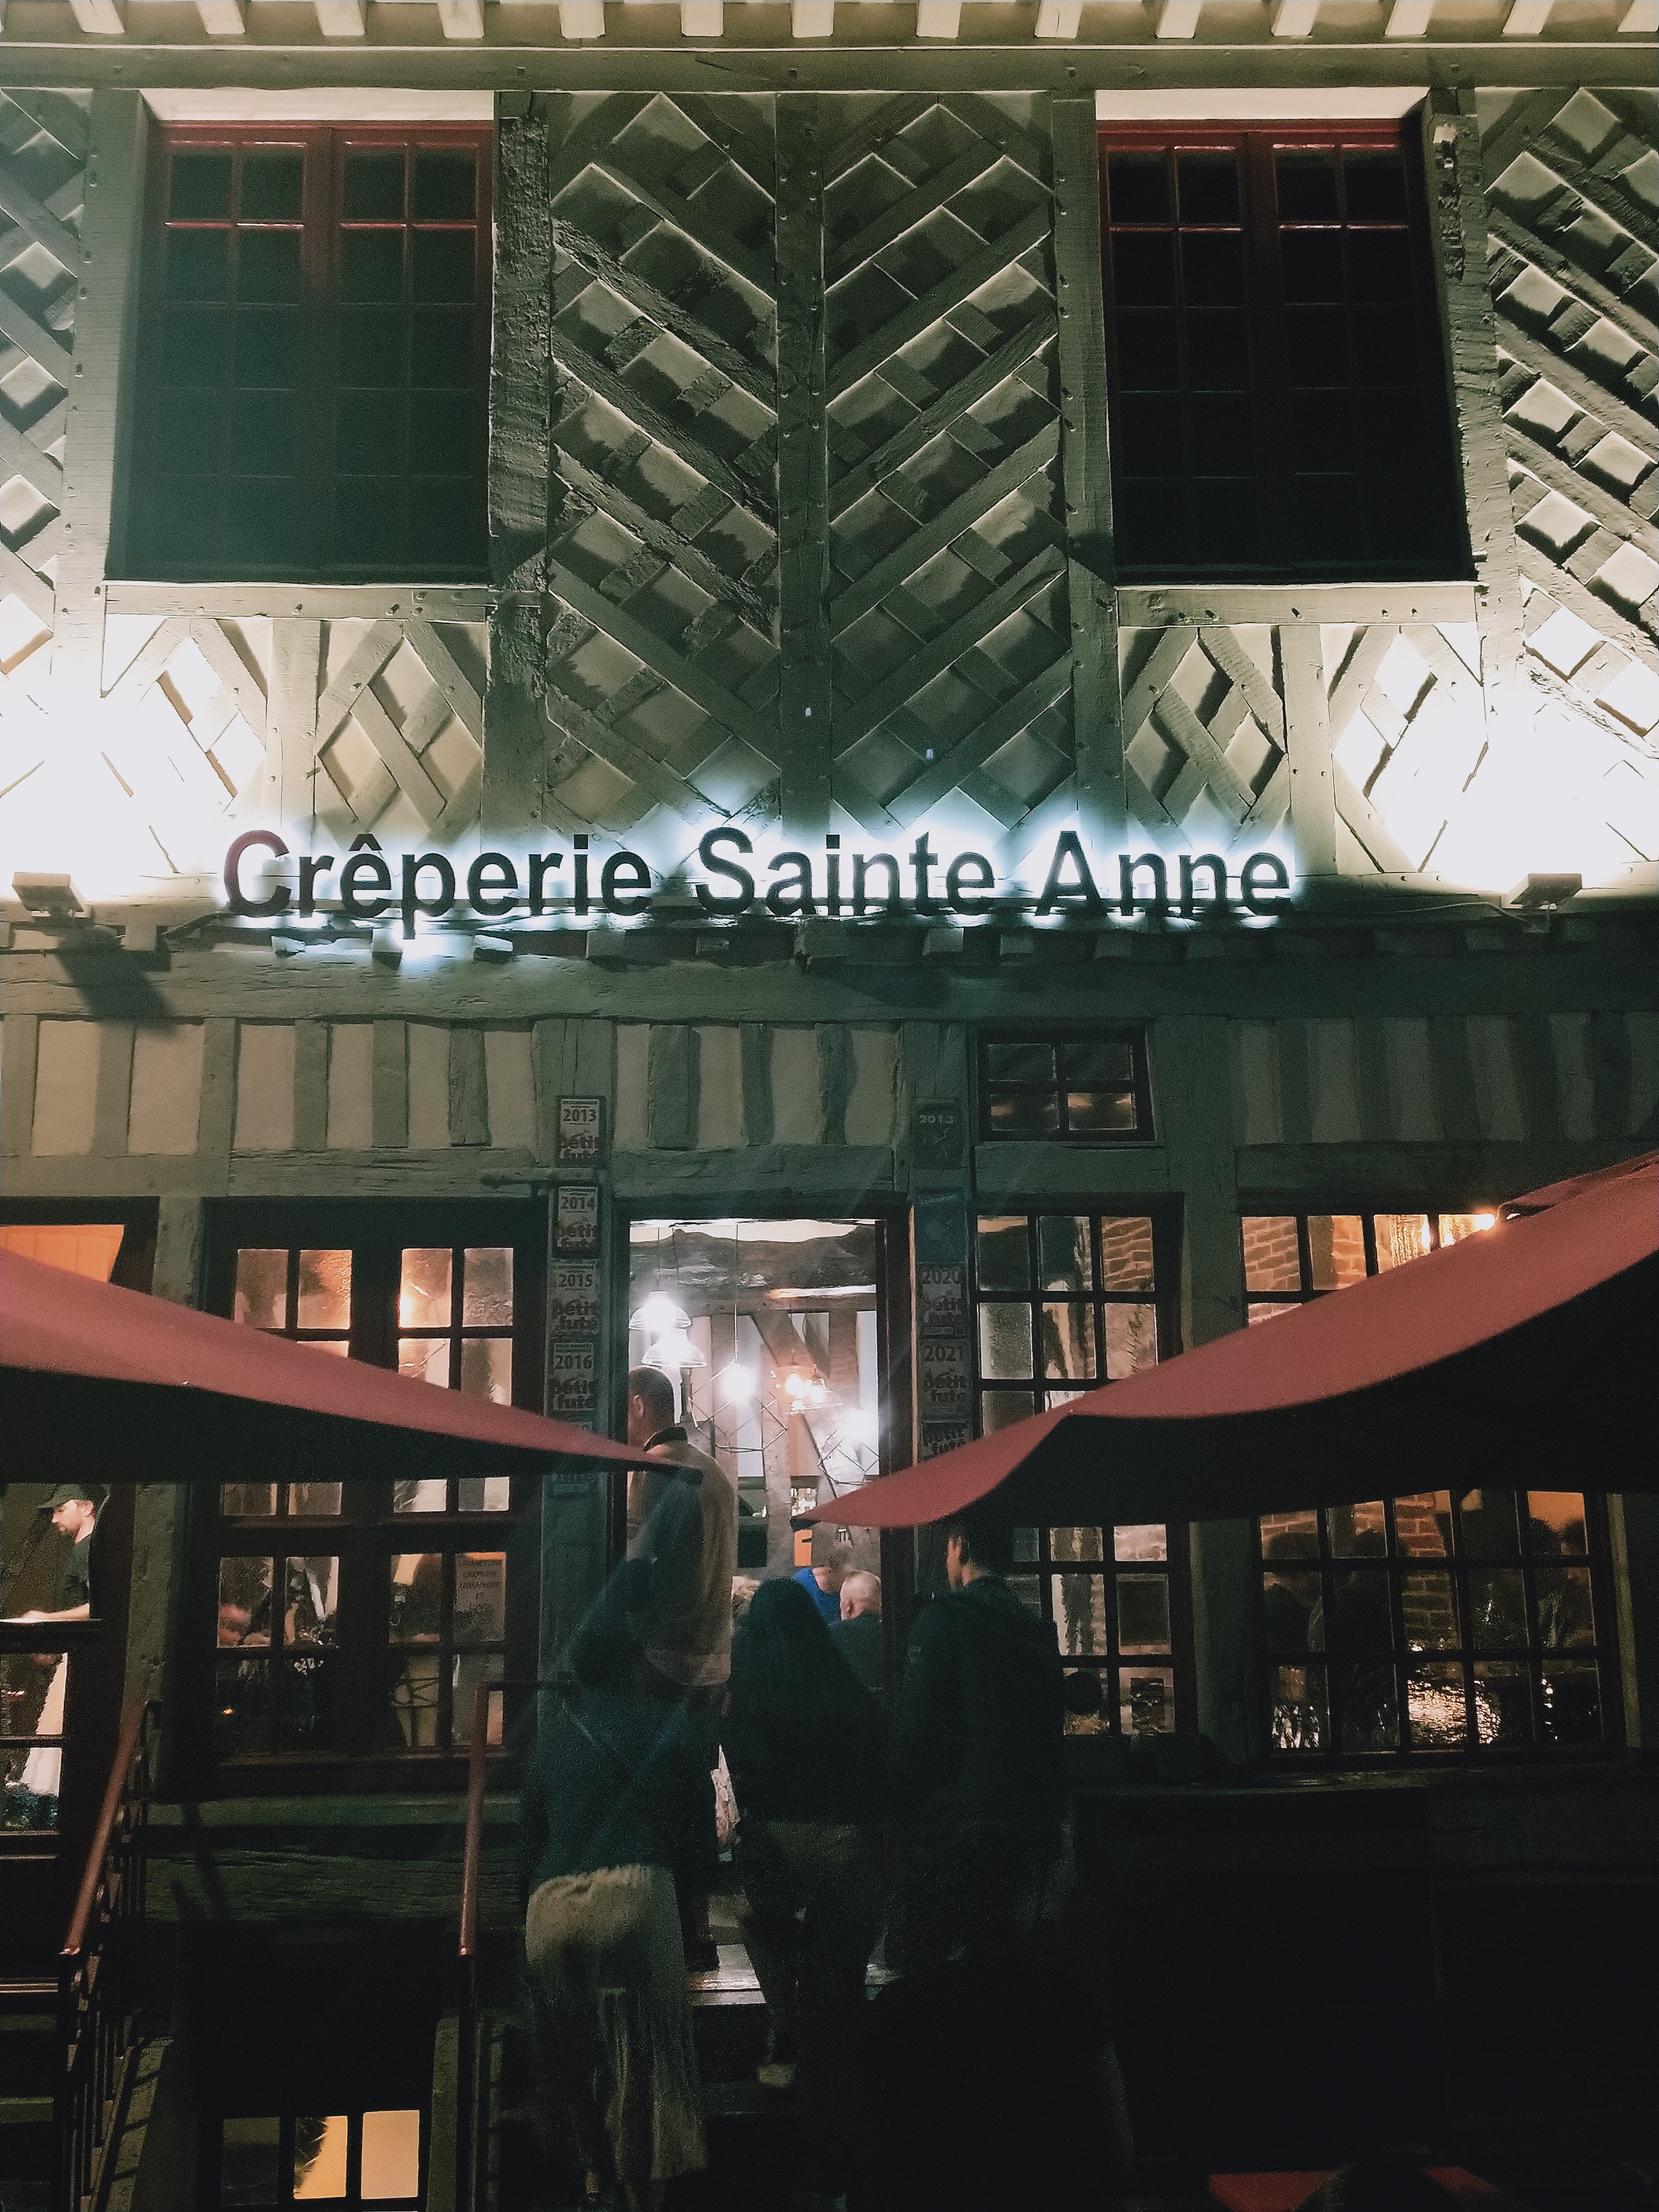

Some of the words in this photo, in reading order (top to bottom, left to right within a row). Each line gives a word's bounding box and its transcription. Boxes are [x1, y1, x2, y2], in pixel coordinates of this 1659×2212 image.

[223, 830, 652, 939] Crêperie
[696, 827, 995, 916] Sainte
[1036, 830, 1289, 917] Anne
[563, 1108, 596, 1122] 2013
[561, 1196, 595, 1210] 2014
[558, 1274, 593, 1287] 2015
[921, 1266, 962, 1285] 2020
[924, 1345, 963, 1361] 2021
[555, 1354, 592, 1369] 2016
